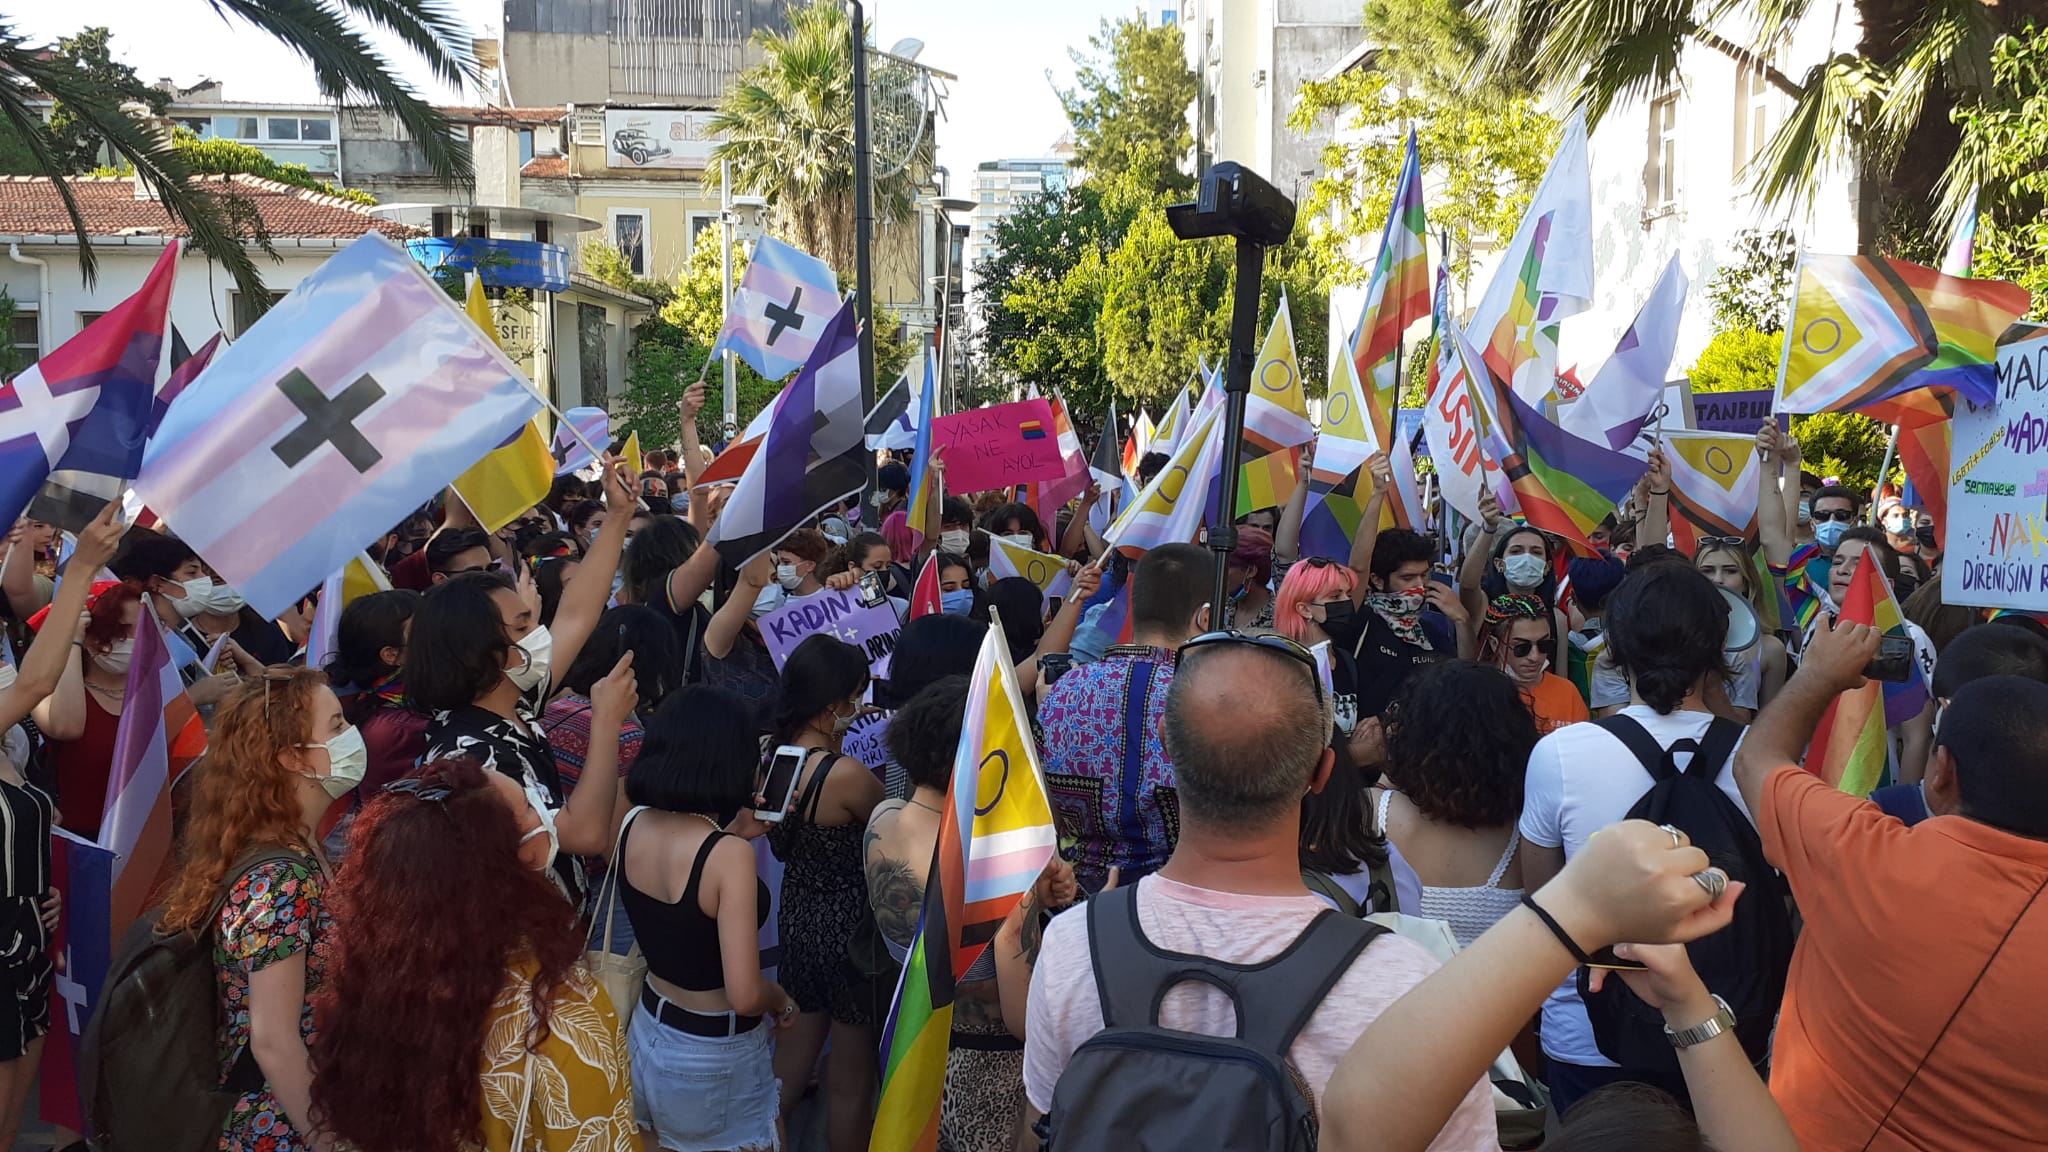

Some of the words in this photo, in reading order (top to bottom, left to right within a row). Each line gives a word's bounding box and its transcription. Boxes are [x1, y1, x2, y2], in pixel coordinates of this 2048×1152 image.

[943, 411, 1008, 449] YASAK
[973, 439, 1004, 460] NE
[1002, 452, 1046, 475] AYOL
[769, 591, 852, 645] KADIN
